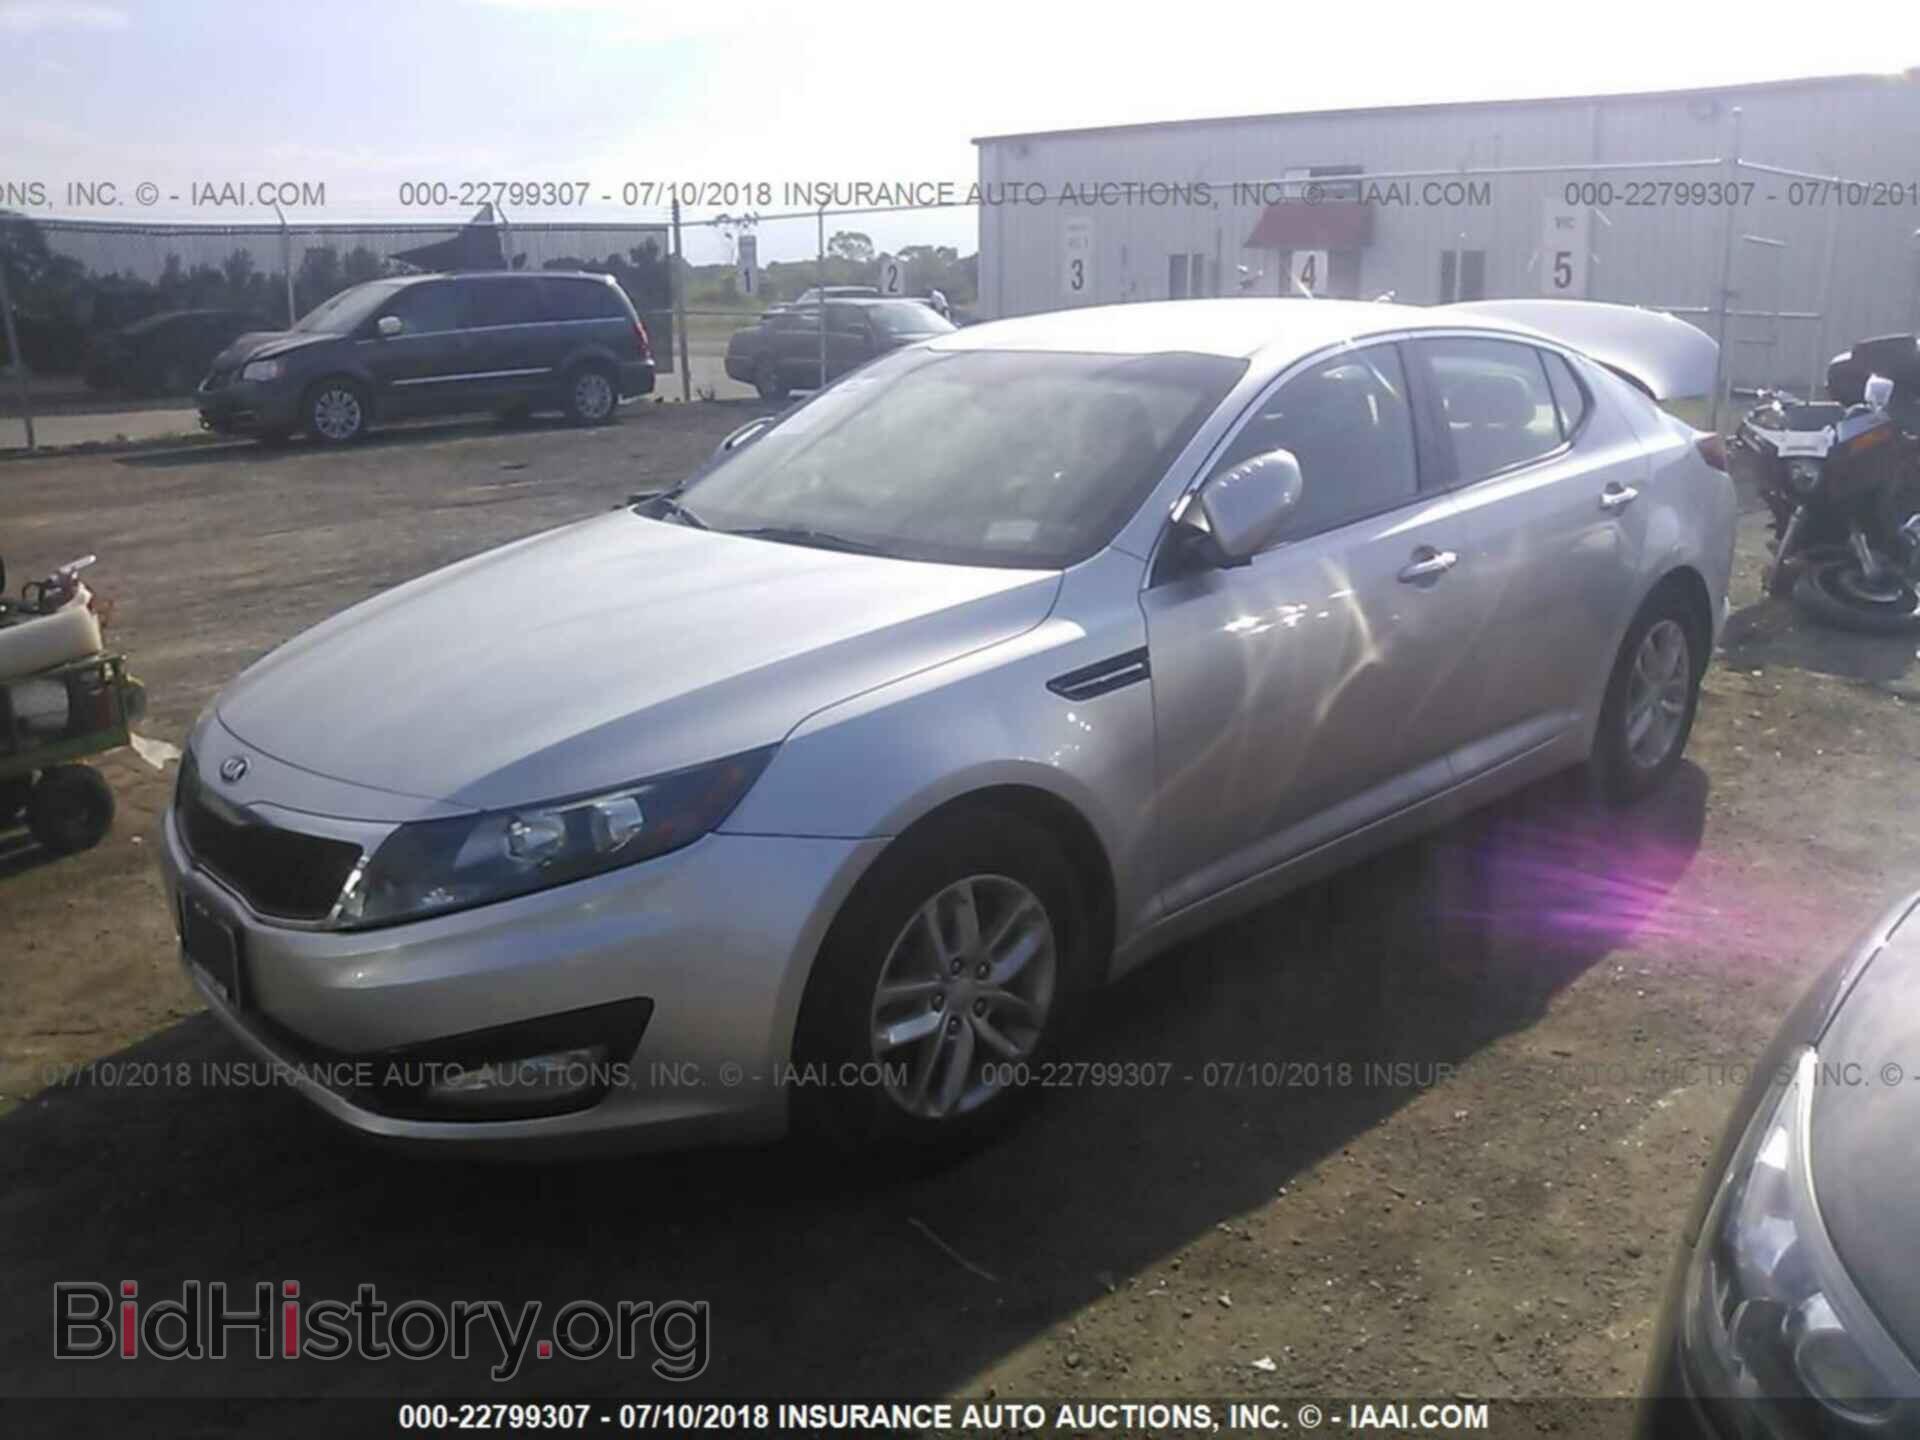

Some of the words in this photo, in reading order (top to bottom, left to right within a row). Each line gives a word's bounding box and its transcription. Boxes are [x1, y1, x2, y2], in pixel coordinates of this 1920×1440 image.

[888, 264, 899, 293] 2
[1071, 259, 1084, 291] 3
[1300, 254, 1316, 291] 4
[1554, 251, 1572, 289] 5
